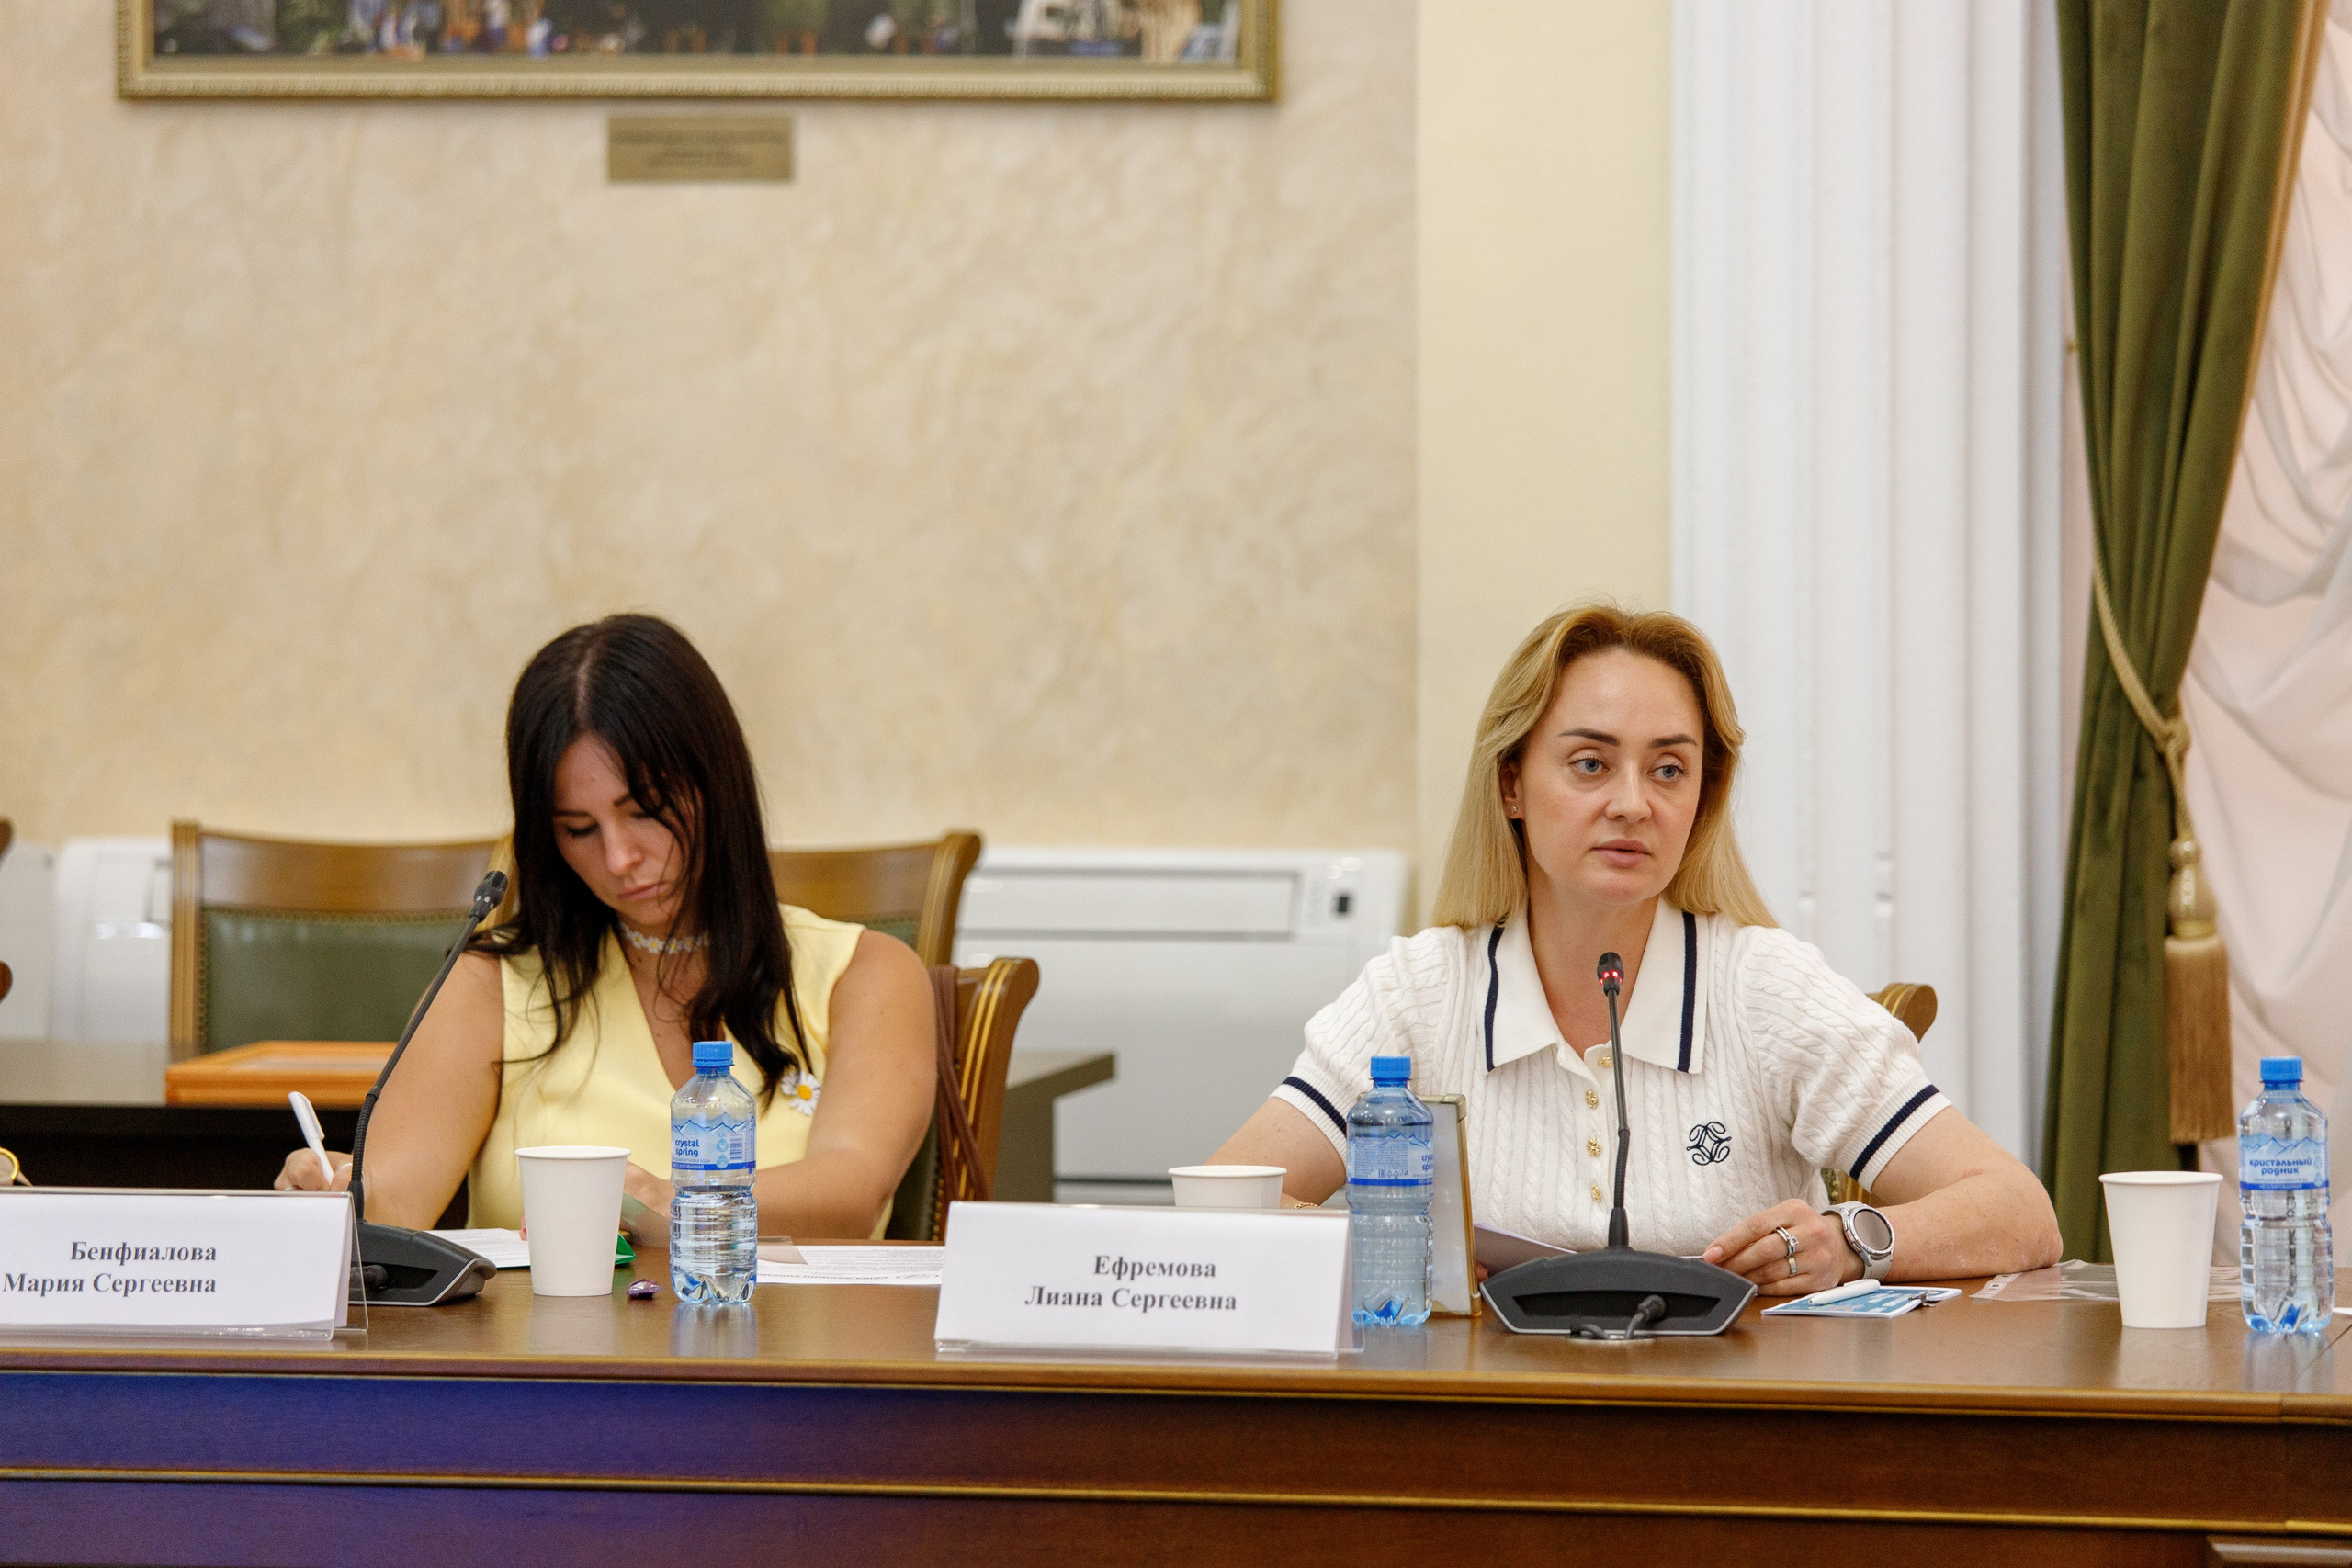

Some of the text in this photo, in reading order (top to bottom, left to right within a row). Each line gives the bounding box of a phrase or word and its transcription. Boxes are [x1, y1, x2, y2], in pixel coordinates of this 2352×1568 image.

[675, 1139, 699, 1148] crystal
[675, 1148, 699, 1157] spring
[2249, 1157, 2312, 1168] кристальный
[2261, 1167, 2300, 1176] родник
[71, 1241, 217, 1266] Бенфиалова
[1093, 1255, 1216, 1281] Ефремова
[3, 1273, 216, 1298] Мария Сергеевна
[1024, 1286, 1237, 1314] Лиана Сергеевна
